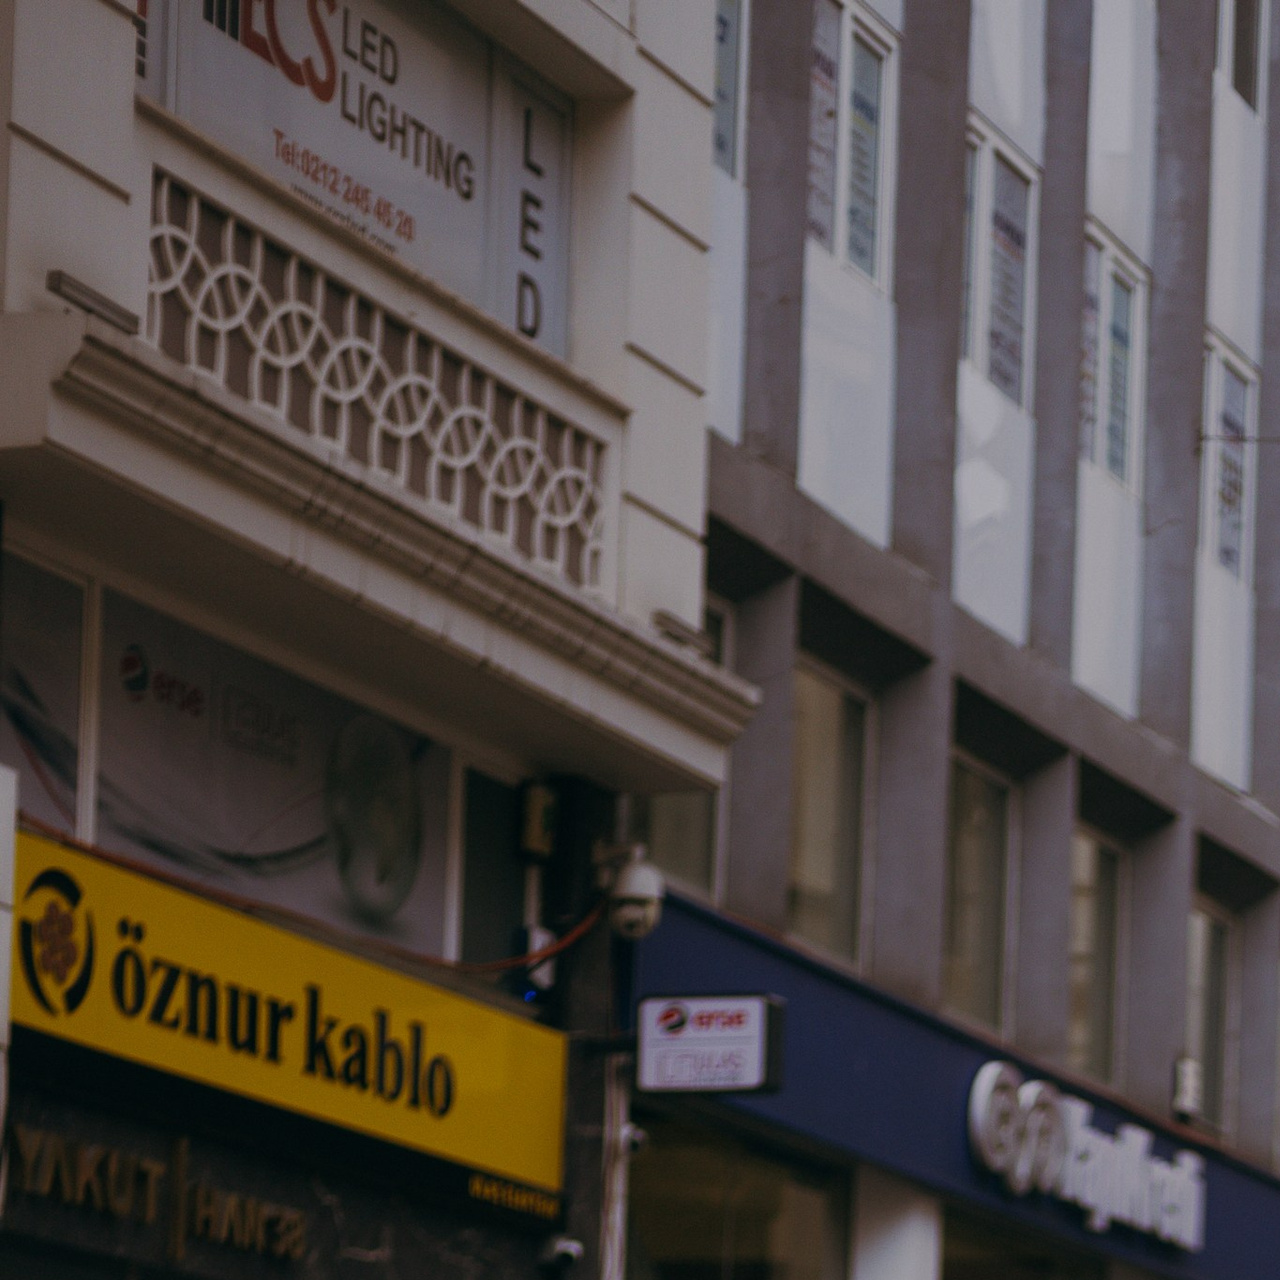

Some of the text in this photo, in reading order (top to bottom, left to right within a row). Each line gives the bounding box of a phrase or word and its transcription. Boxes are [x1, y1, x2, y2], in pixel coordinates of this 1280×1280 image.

[341, 6, 399, 85] LED
[339, 71, 475, 201] LIGHTING
[112, 916, 455, 1119] öznur kablo
